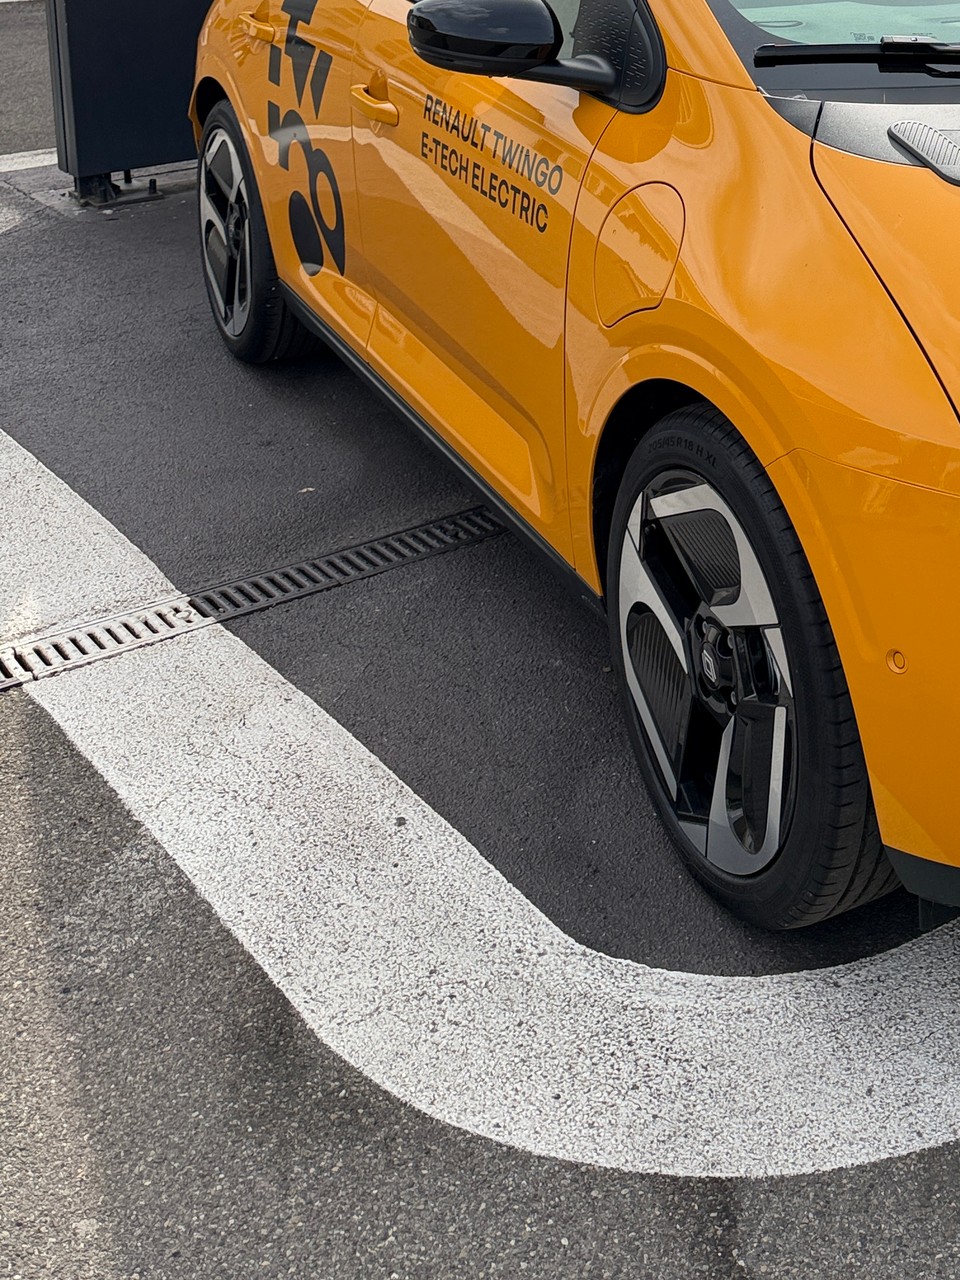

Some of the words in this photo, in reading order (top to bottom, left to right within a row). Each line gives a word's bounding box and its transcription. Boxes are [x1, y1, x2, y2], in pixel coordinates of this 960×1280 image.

[421, 131, 470, 185] E-TECH
[471, 161, 549, 233] ELECTRIC
[423, 94, 492, 152] RENAULT
[492, 129, 563, 196] TWINGO
